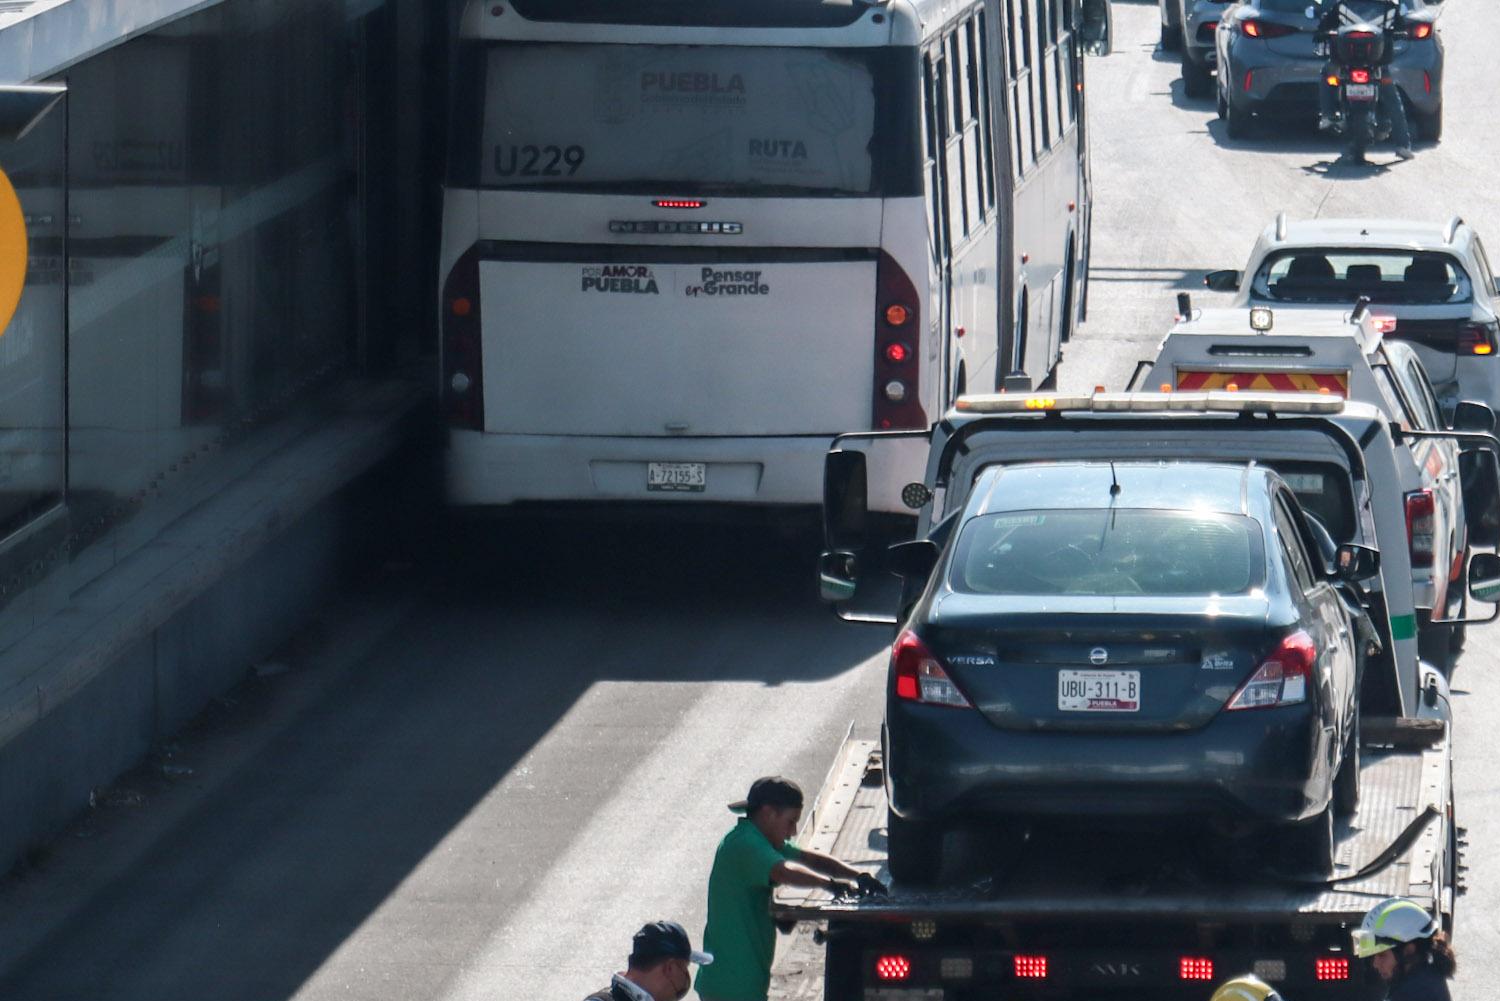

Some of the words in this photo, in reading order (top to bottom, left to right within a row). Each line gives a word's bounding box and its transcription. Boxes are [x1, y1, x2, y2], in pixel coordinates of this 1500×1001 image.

[641, 71, 746, 93] PUEBLA
[749, 138, 808, 160] RUTA
[494, 144, 585, 177] U229
[601, 265, 648, 278] AMOR
[701, 267, 762, 283] Pensar
[581, 277, 660, 295] PUEBLA
[703, 280, 770, 295] Grande
[946, 656, 994, 665] VERSA
[1061, 680, 1136, 699] UBU-311-B
